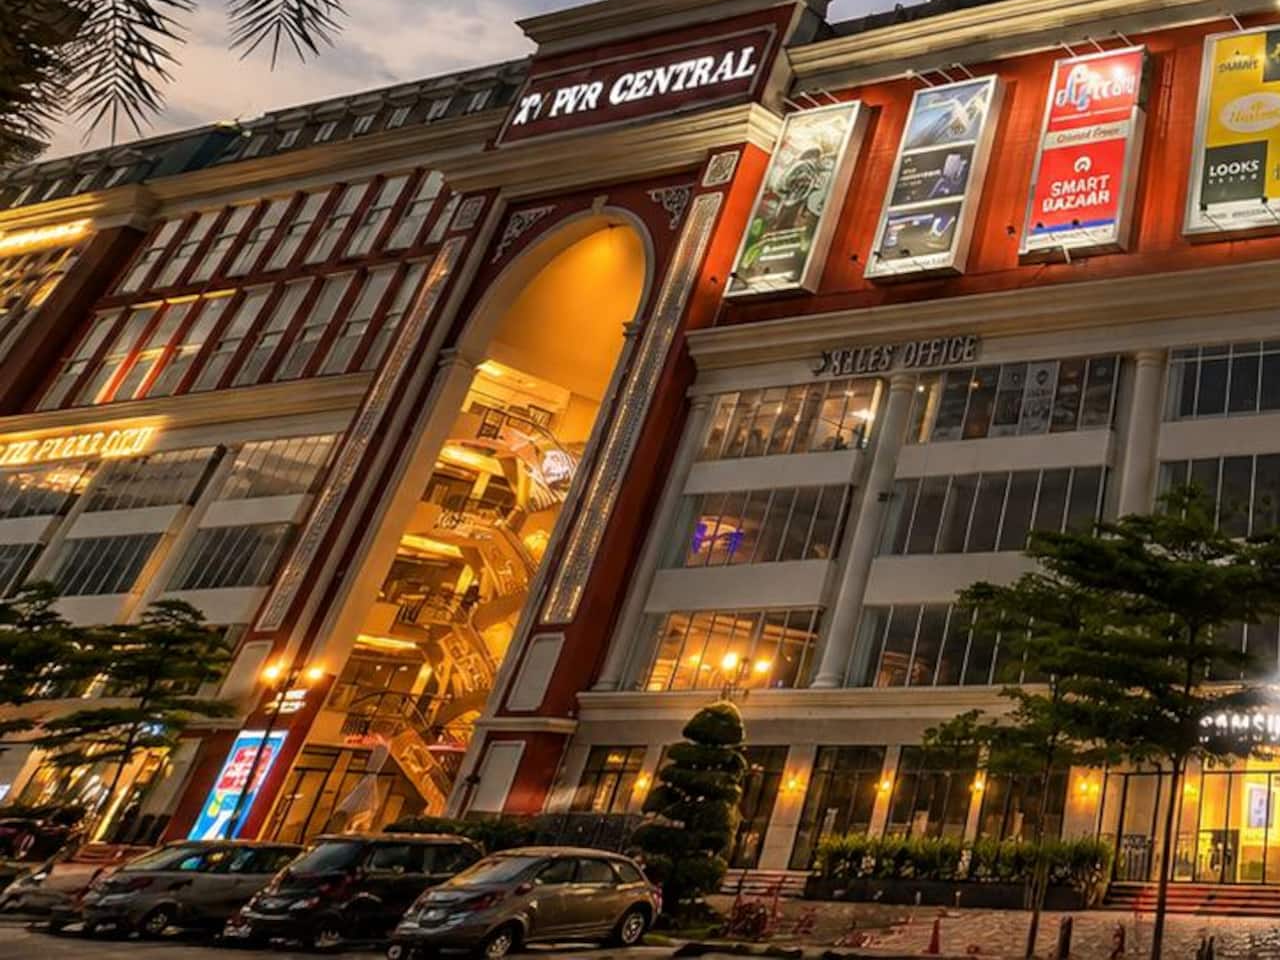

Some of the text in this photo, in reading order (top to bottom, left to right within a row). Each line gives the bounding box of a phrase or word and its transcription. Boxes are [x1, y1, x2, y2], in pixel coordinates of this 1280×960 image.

[550, 81, 602, 118] PVR
[609, 45, 758, 106] CENTRAL
[1208, 159, 1260, 177] LOOKS
[1050, 173, 1110, 197] SMART
[1042, 190, 1111, 213] BAZAAR
[902, 335, 978, 368] OFFICE
